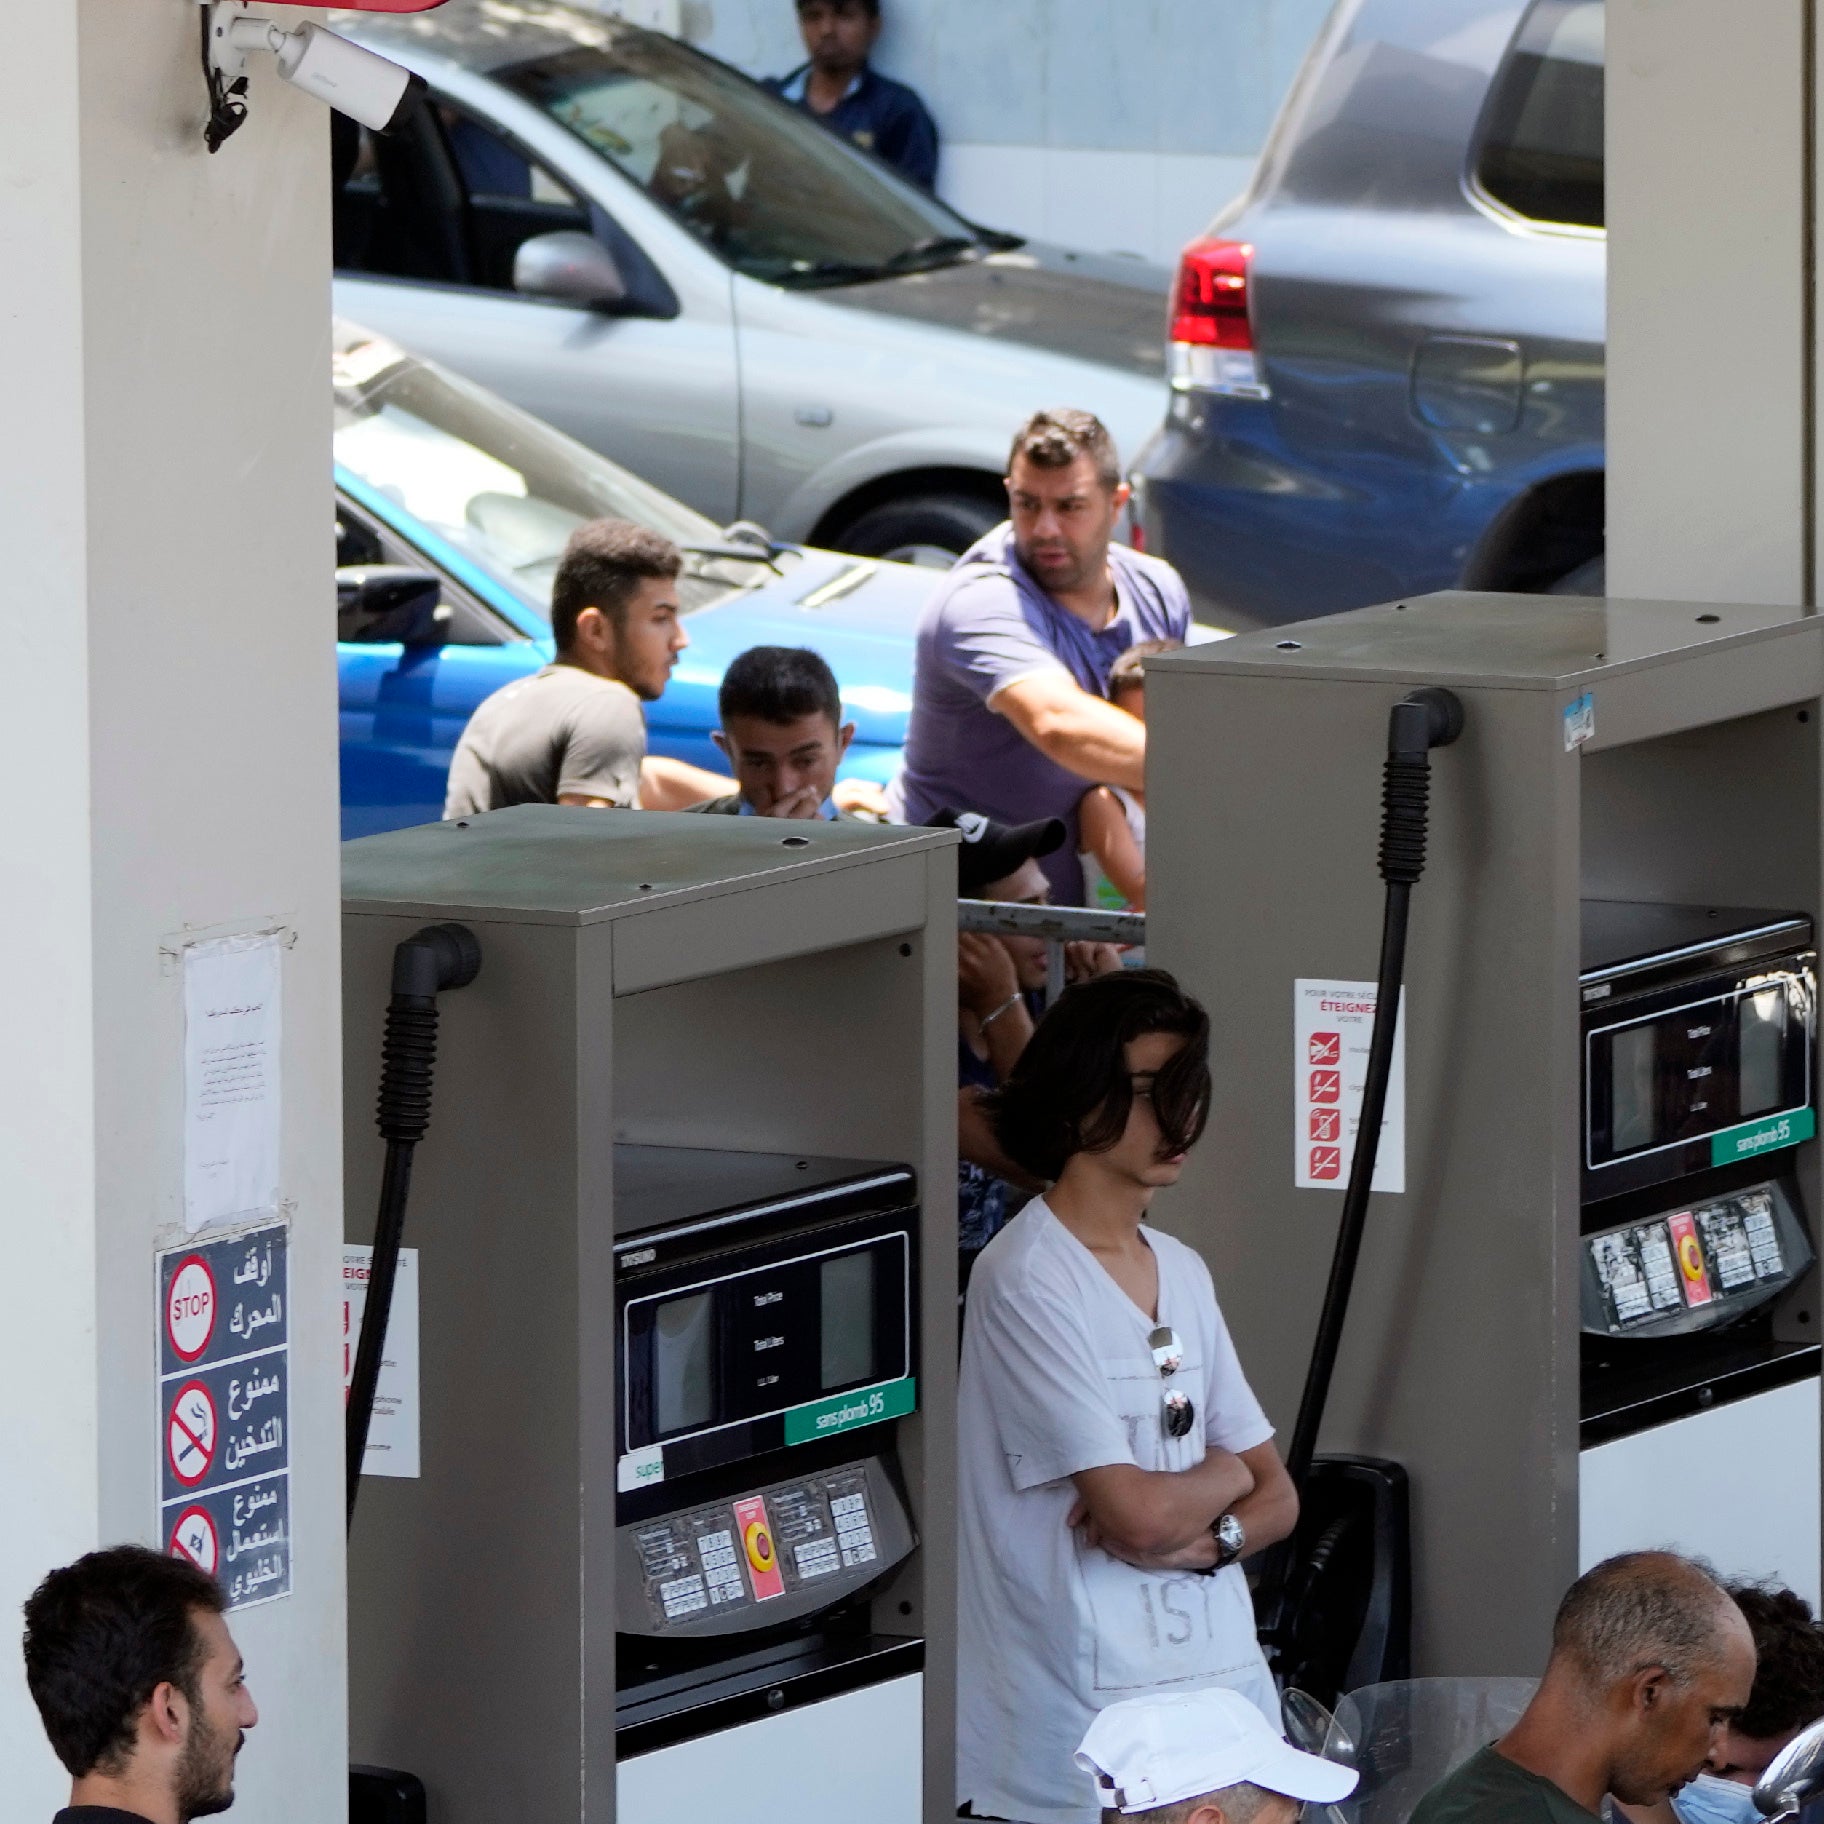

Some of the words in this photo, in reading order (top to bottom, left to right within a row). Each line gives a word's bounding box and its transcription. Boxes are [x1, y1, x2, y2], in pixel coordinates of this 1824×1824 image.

[173, 1291, 209, 1322] STOP
[229, 1293, 283, 1339] المحرك
[228, 1367, 280, 1421] ممنوع
[868, 1391, 885, 1416] 95
[233, 1485, 279, 1527] ممنوع
